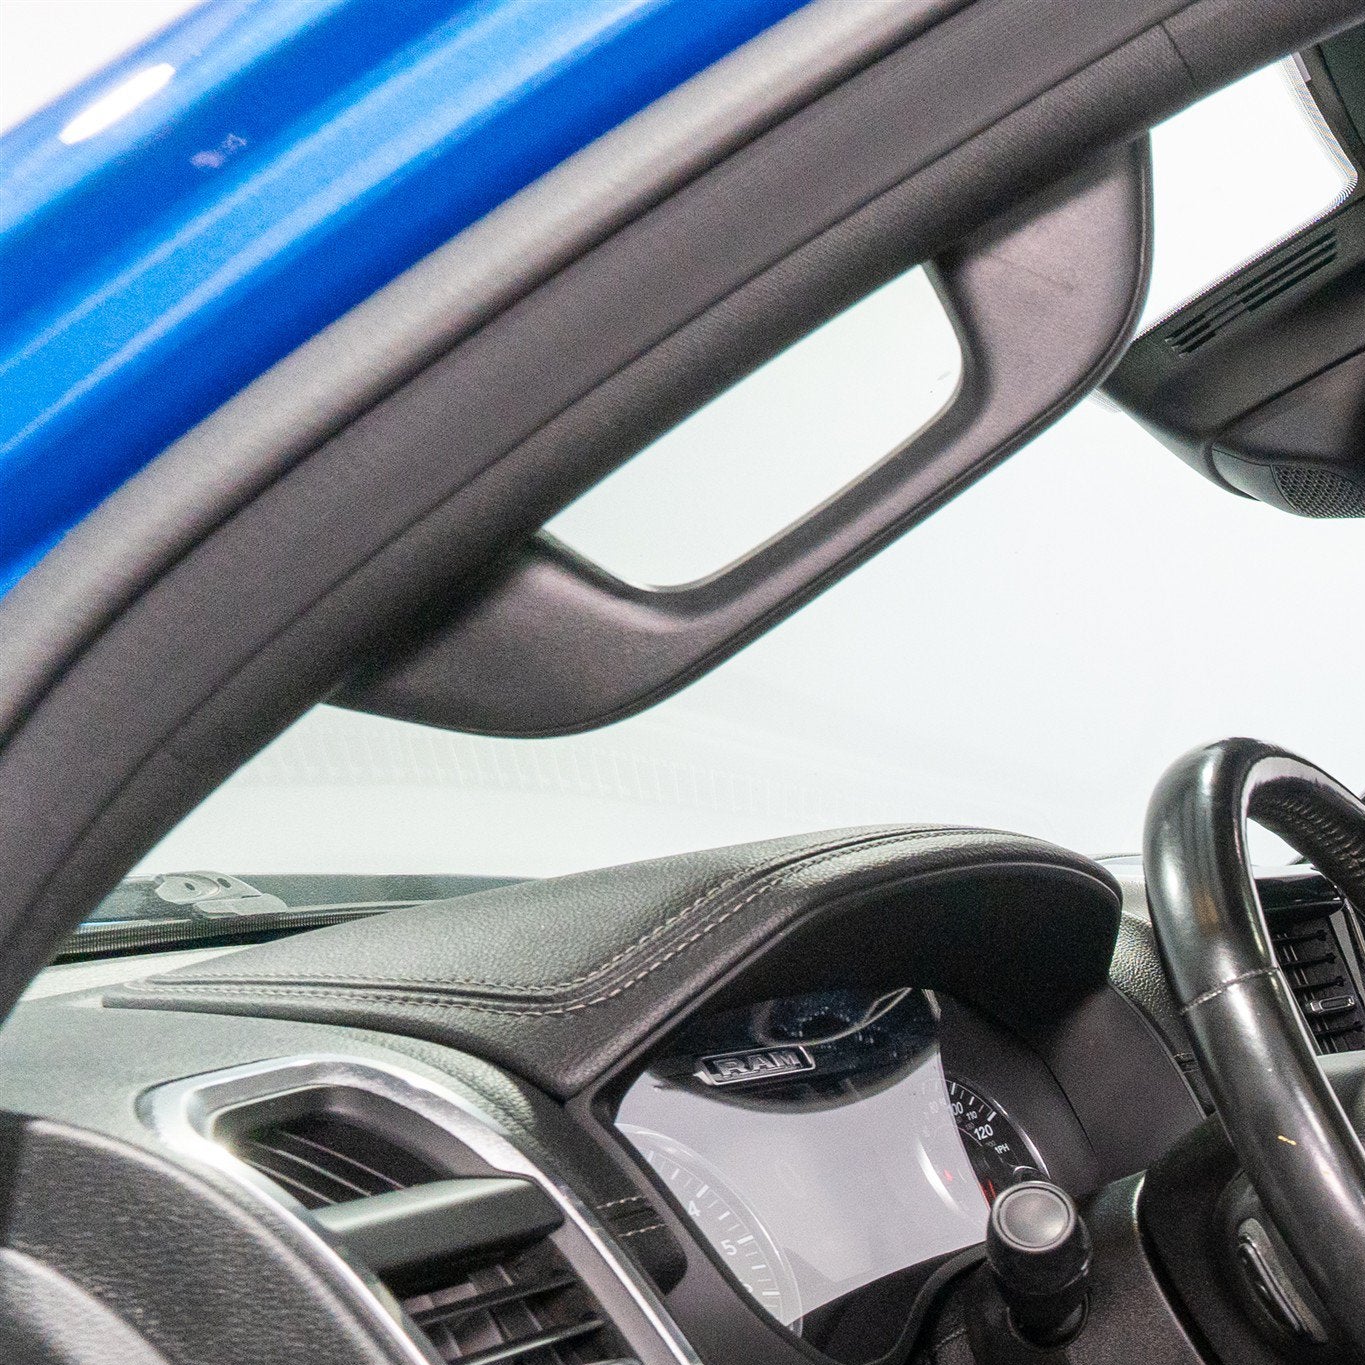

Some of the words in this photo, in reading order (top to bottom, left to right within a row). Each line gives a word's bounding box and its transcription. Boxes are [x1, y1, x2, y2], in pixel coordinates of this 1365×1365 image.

[713, 1050, 802, 1078] RAM
[966, 1110, 978, 1121] 110
[974, 1124, 994, 1140] 120
[688, 1200, 700, 1217] 4
[721, 1239, 737, 1256] 5
